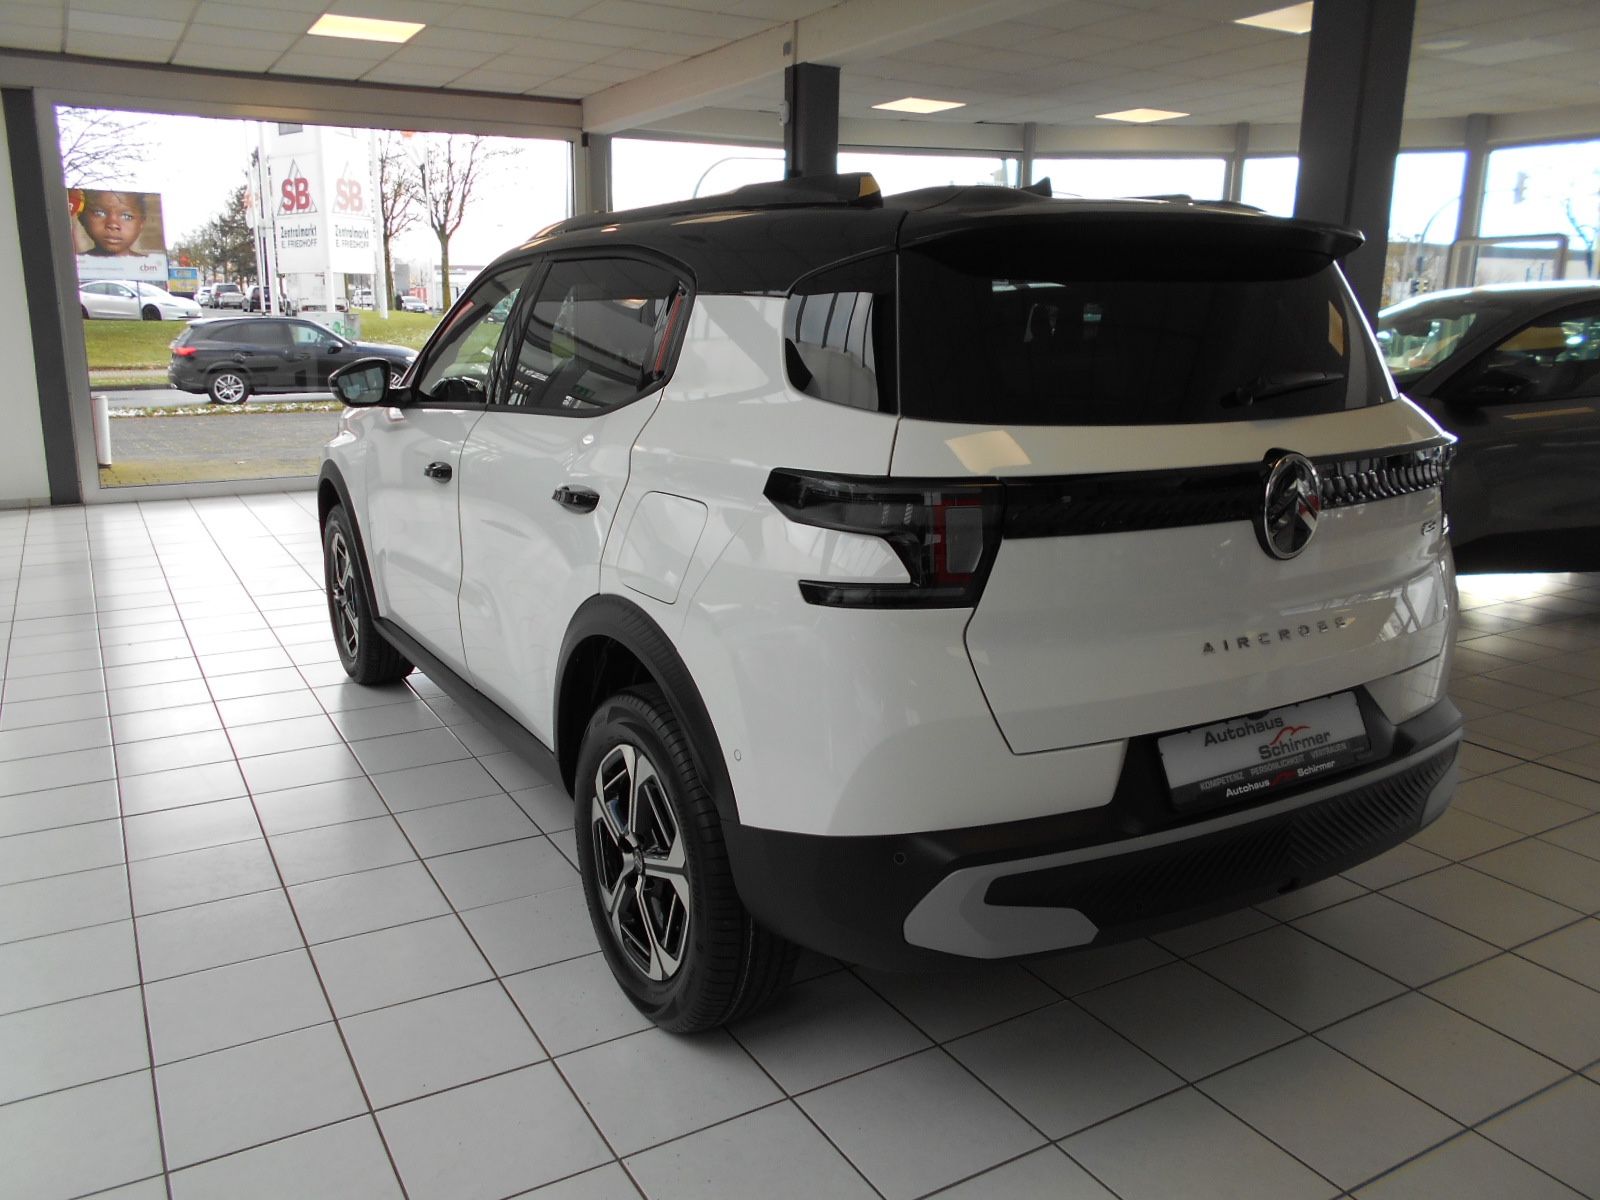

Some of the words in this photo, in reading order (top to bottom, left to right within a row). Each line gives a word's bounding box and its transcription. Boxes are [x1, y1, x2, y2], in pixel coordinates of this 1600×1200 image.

[282, 178, 310, 211] SB
[336, 178, 363, 211] SB
[281, 225, 317, 238] Zentralmarkt
[288, 239, 317, 248] FRIEDHOFF
[335, 225, 369, 239] Zentralmarkt
[139, 263, 158, 272] cbm
[1204, 717, 1284, 747] Autohaus
[1259, 731, 1331, 760] Schirmer
[1225, 778, 1270, 798] Autohaus
[1296, 760, 1336, 777] Schirmer
